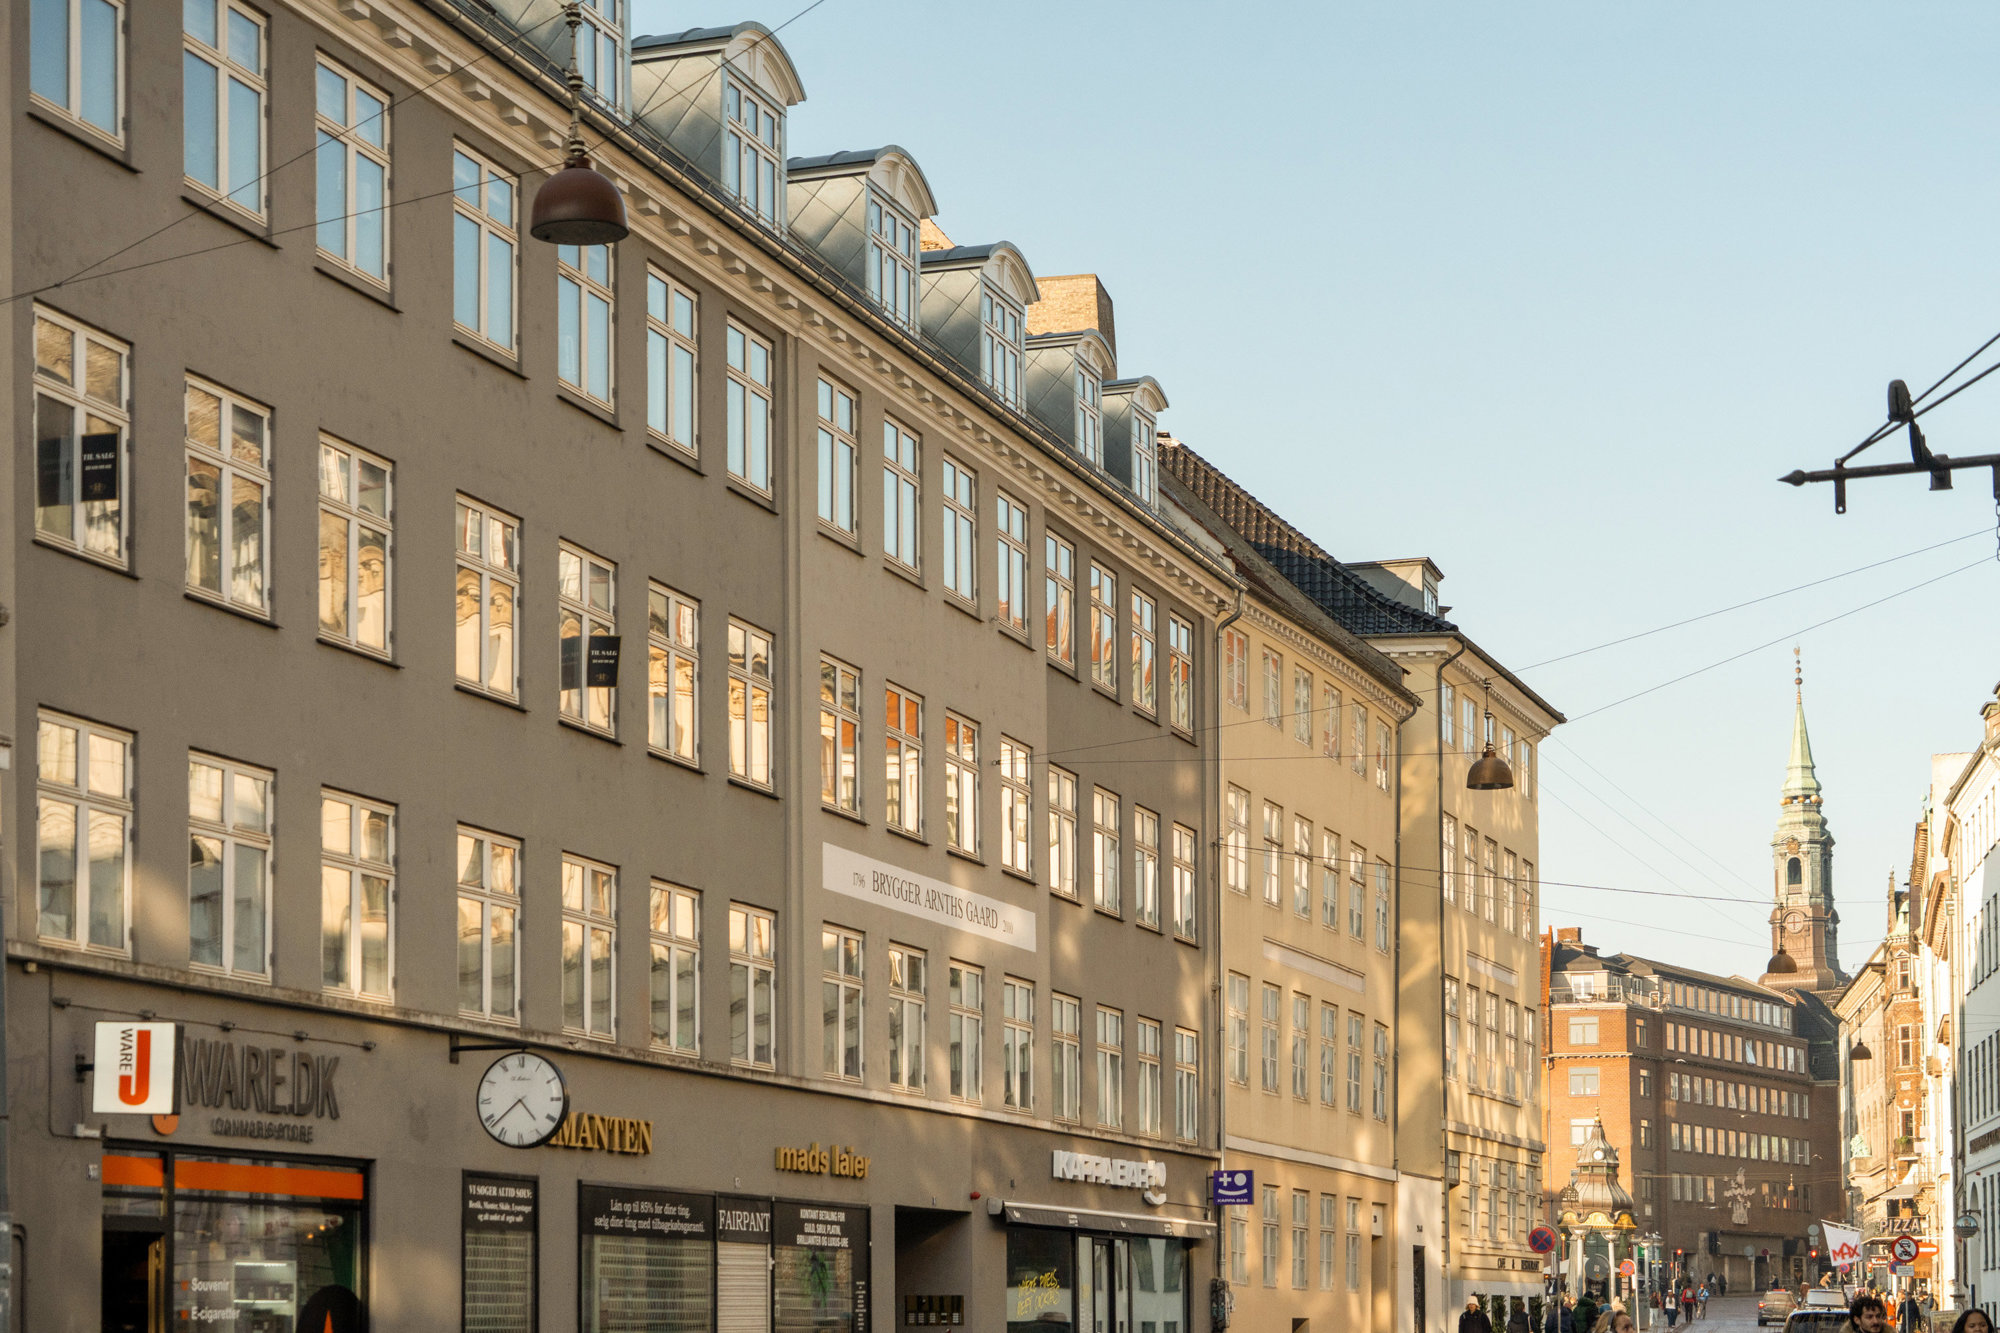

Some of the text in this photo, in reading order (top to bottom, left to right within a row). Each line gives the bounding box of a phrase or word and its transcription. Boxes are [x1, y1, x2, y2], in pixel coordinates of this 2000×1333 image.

[853, 872, 866, 889] 1796
[872, 870, 922, 907] BRYGGER
[924, 888, 964, 919] ARNTHS
[966, 901, 998, 929] GAARD
[119, 1028, 133, 1071] WARE
[118, 1029, 151, 1105] J
[182, 1037, 340, 1120] WARE.DK
[548, 1111, 654, 1155] MANTEN
[775, 1142, 829, 1174] mads
[610, 1199, 622, 1211] Lån
[623, 1203, 632, 1214] op
[640, 1202, 654, 1213] 85%
[654, 1203, 663, 1214] for
[663, 1204, 677, 1215] dine
[609, 1216, 624, 1228] dine
[624, 1216, 637, 1231] ting
[637, 1218, 651, 1229] med
[719, 1210, 770, 1233] FAIRPANT
[1879, 1218, 1922, 1233] PIZZA
[1831, 1242, 1861, 1262] MAX
[191, 1277, 230, 1291] Souvenir
